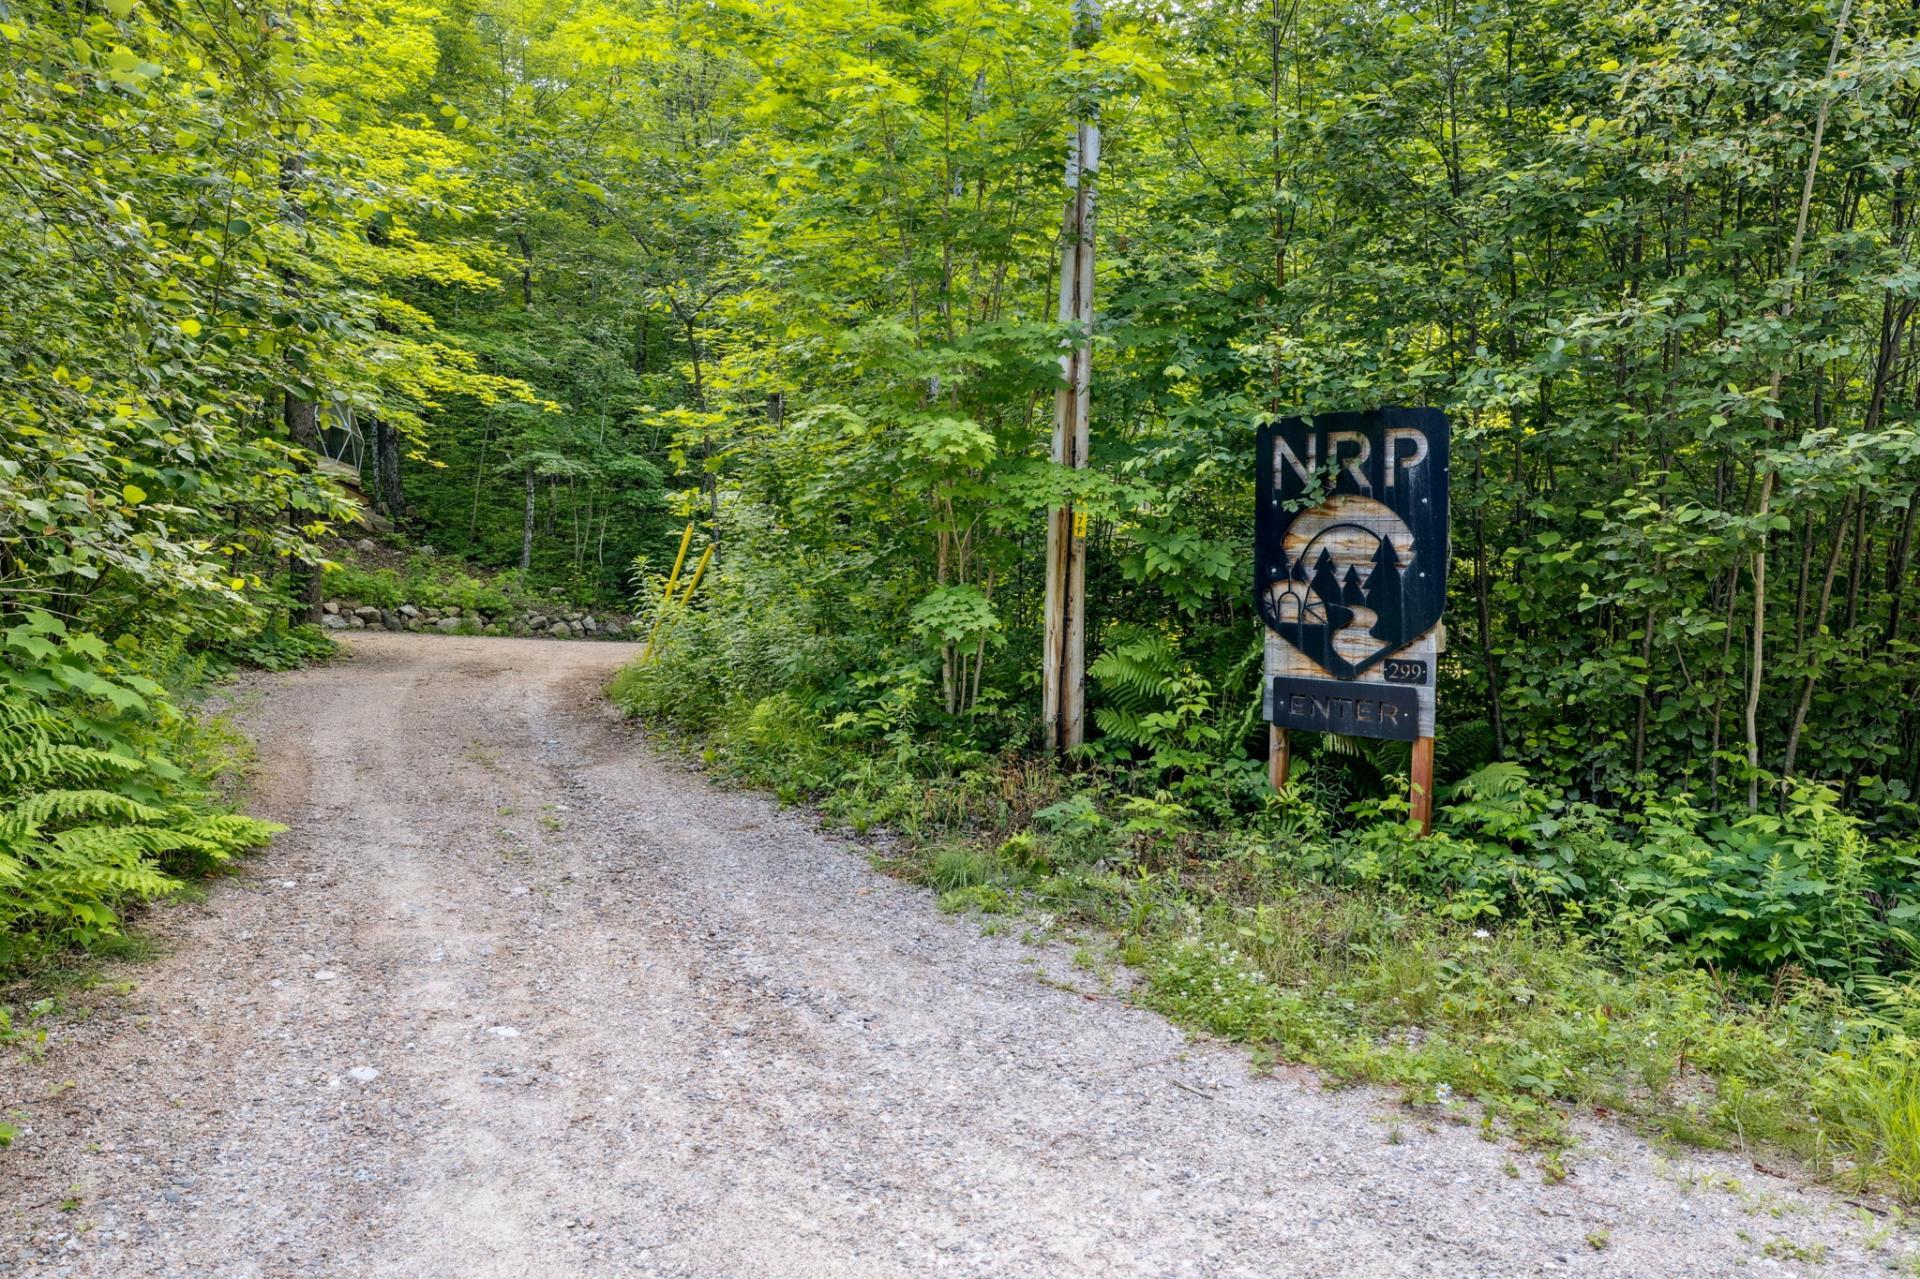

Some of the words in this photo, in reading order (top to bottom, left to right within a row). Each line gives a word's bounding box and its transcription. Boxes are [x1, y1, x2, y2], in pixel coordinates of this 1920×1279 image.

[1272, 427, 1429, 490] NRP
[1388, 662, 1421, 680] 299
[1288, 693, 1398, 726] ENTER
